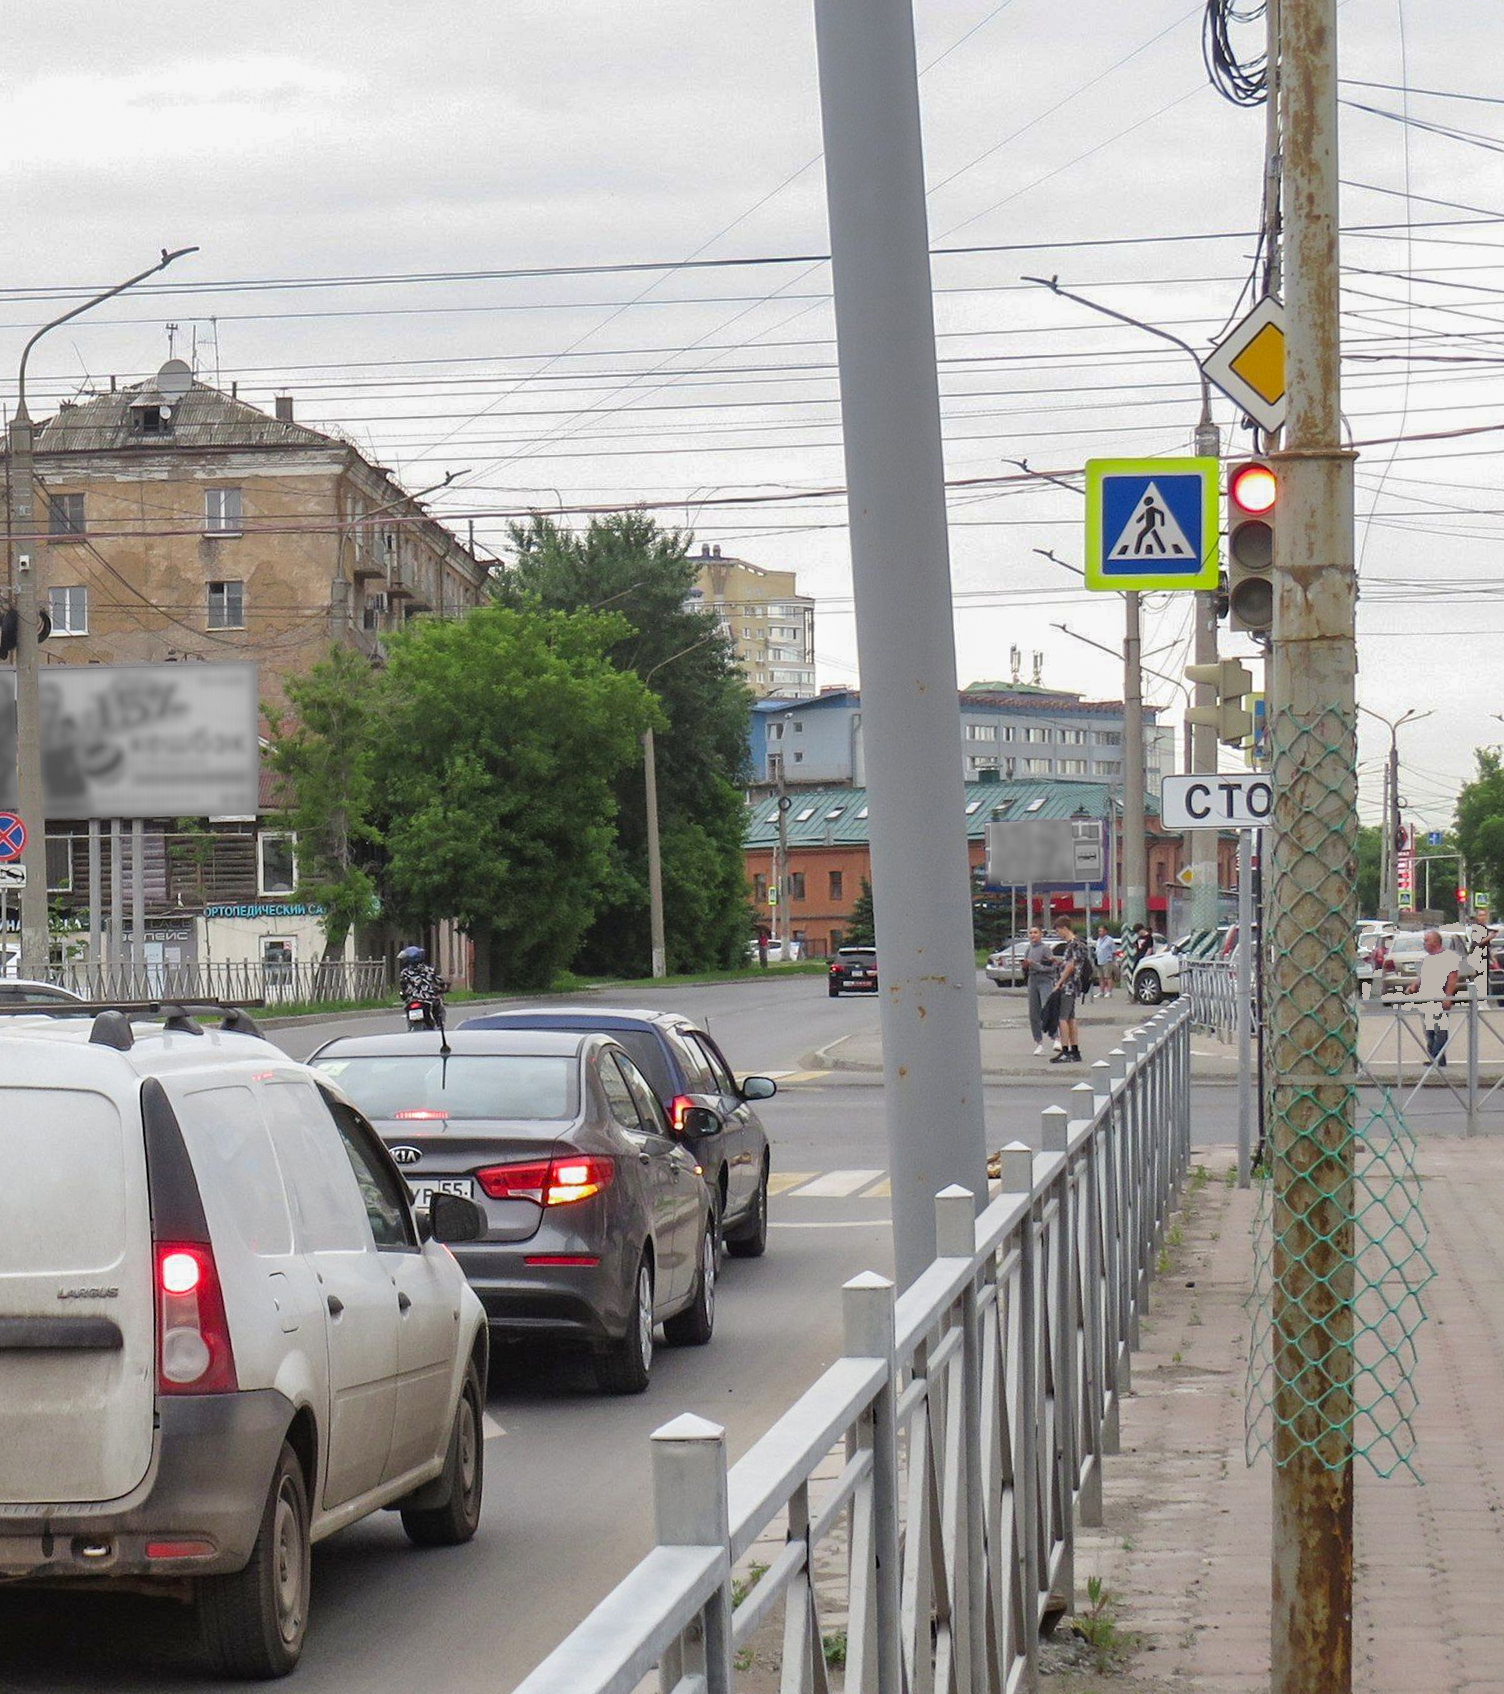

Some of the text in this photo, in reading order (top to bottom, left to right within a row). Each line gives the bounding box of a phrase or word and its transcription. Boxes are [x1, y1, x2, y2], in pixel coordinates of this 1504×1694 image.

[1184, 782, 1273, 819] СТО
[204, 903, 306, 919] ОРТОПЕДИЧЕСКИЙ
[391, 1150, 416, 1162] KIA
[56, 1287, 119, 1299] LARGUS
